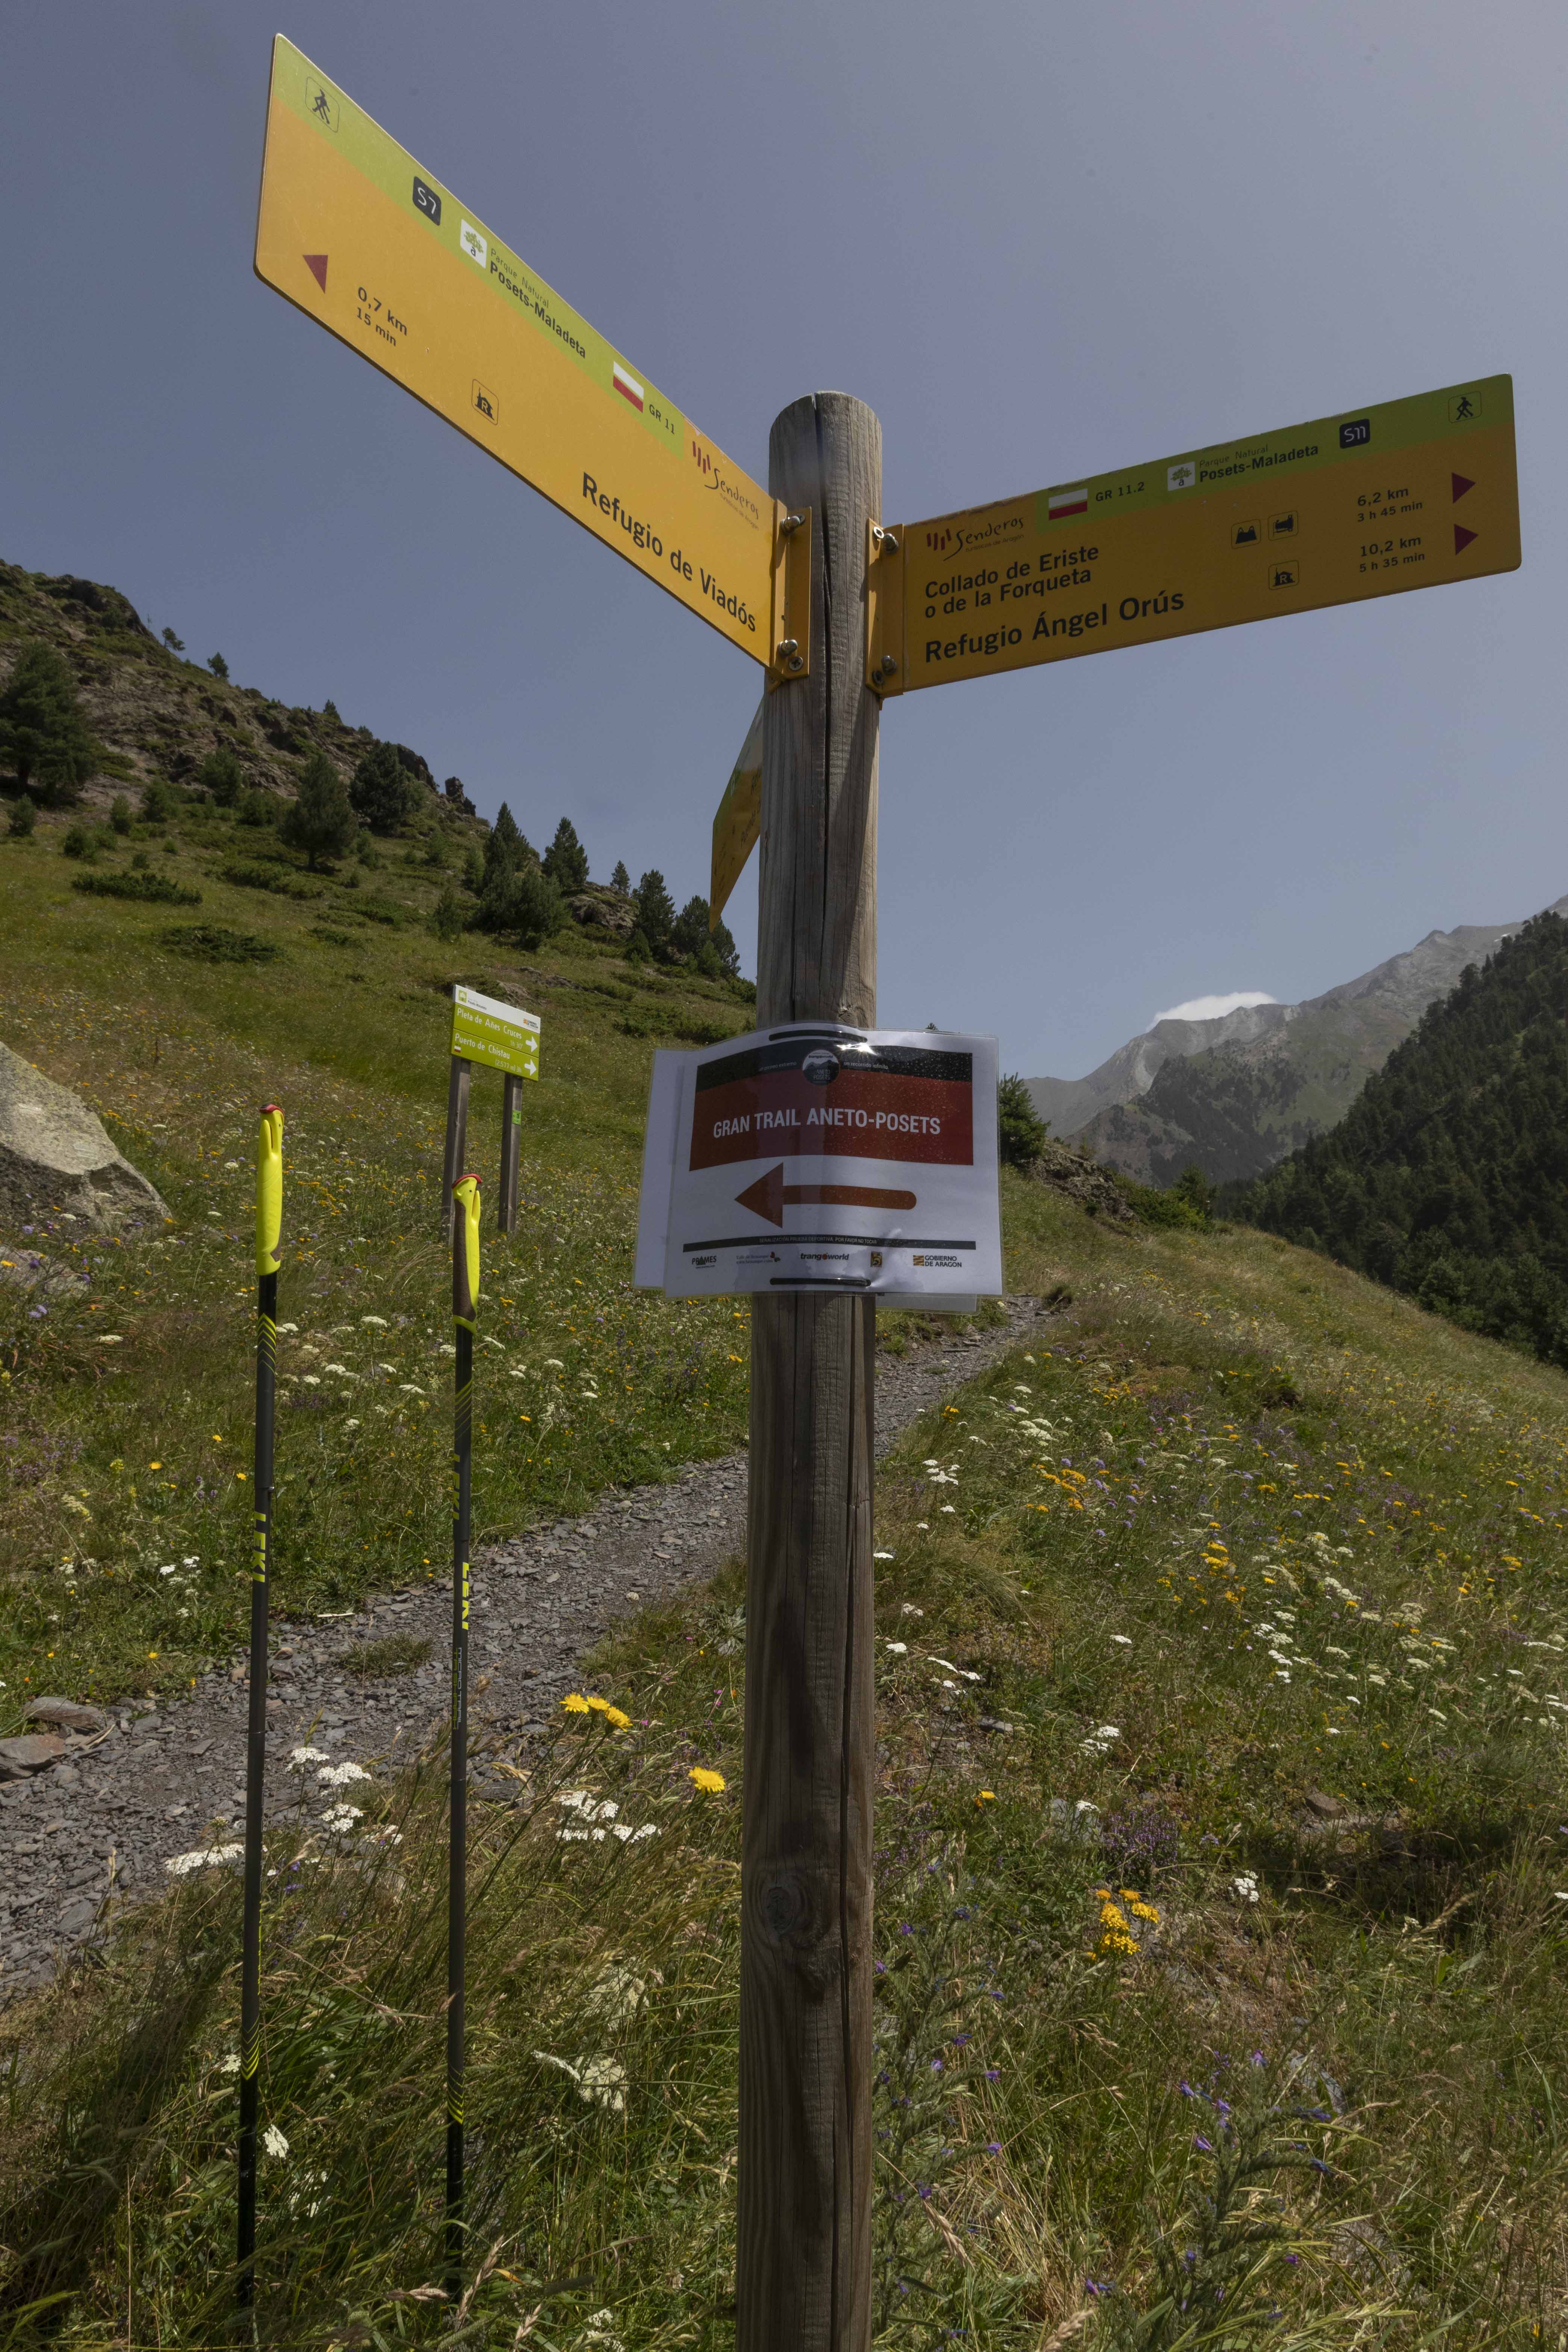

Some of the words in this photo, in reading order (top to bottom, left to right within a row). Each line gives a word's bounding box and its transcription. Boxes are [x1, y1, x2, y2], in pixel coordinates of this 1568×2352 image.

[418, 187, 436, 214] S7
[491, 248, 517, 279] Parque
[522, 277, 549, 309] Natural
[357, 307, 371, 325] 15
[376, 324, 396, 347] min
[358, 287, 381, 312] 0,7
[388, 309, 407, 336] km
[490, 260, 585, 359] Posets-Maladeta
[649, 404, 662, 422] GR
[665, 418, 675, 436] 11
[1200, 455, 1230, 467] Parque
[1235, 445, 1268, 459] Natural
[1200, 446, 1319, 482] Posets-Maladeta
[704, 468, 758, 520] Senderos
[1096, 490, 1112, 502] GR
[1118, 481, 1145, 496] 11.2
[1357, 492, 1381, 507] 6,2
[1387, 488, 1409, 500] km
[1358, 513, 1364, 522] 3
[1369, 511, 1376, 519] h
[1381, 506, 1396, 517] 45
[1401, 501, 1423, 513] min
[583, 472, 662, 557] Refugio
[670, 549, 693, 581] de
[700, 567, 756, 632] Viadós
[943, 516, 1028, 561] Senderos
[1360, 540, 1393, 557] 10,2
[1400, 536, 1421, 549] km
[925, 569, 998, 598] Collado
[1006, 561, 1030, 580] de
[1040, 546, 1099, 572] Eriste
[1359, 563, 1366, 573] 5
[1371, 562, 1378, 570] h
[1383, 557, 1398, 568] 35
[1403, 552, 1425, 564] min
[925, 605, 936, 618] o
[944, 597, 966, 614] de
[975, 591, 991, 607] la
[1000, 568, 1091, 601] Forqueta
[926, 625, 1022, 663] Refugio
[1032, 603, 1107, 640] Ángel
[1119, 590, 1185, 622] Orús
[457, 1007, 473, 1021] Pleta
[475, 1015, 482, 1025] de
[485, 1018, 500, 1031] Añes
[503, 1025, 522, 1039] Cruces
[455, 1033, 475, 1047] Puerto
[477, 1042, 485, 1051] de
[488, 1045, 510, 1059] Chistau
[714, 1115, 750, 1138] GRAN
[754, 1109, 801, 1130] TRAIL
[806, 1108, 940, 1135] ANETO-POSETS
[253, 1511, 266, 1582] LEKI
